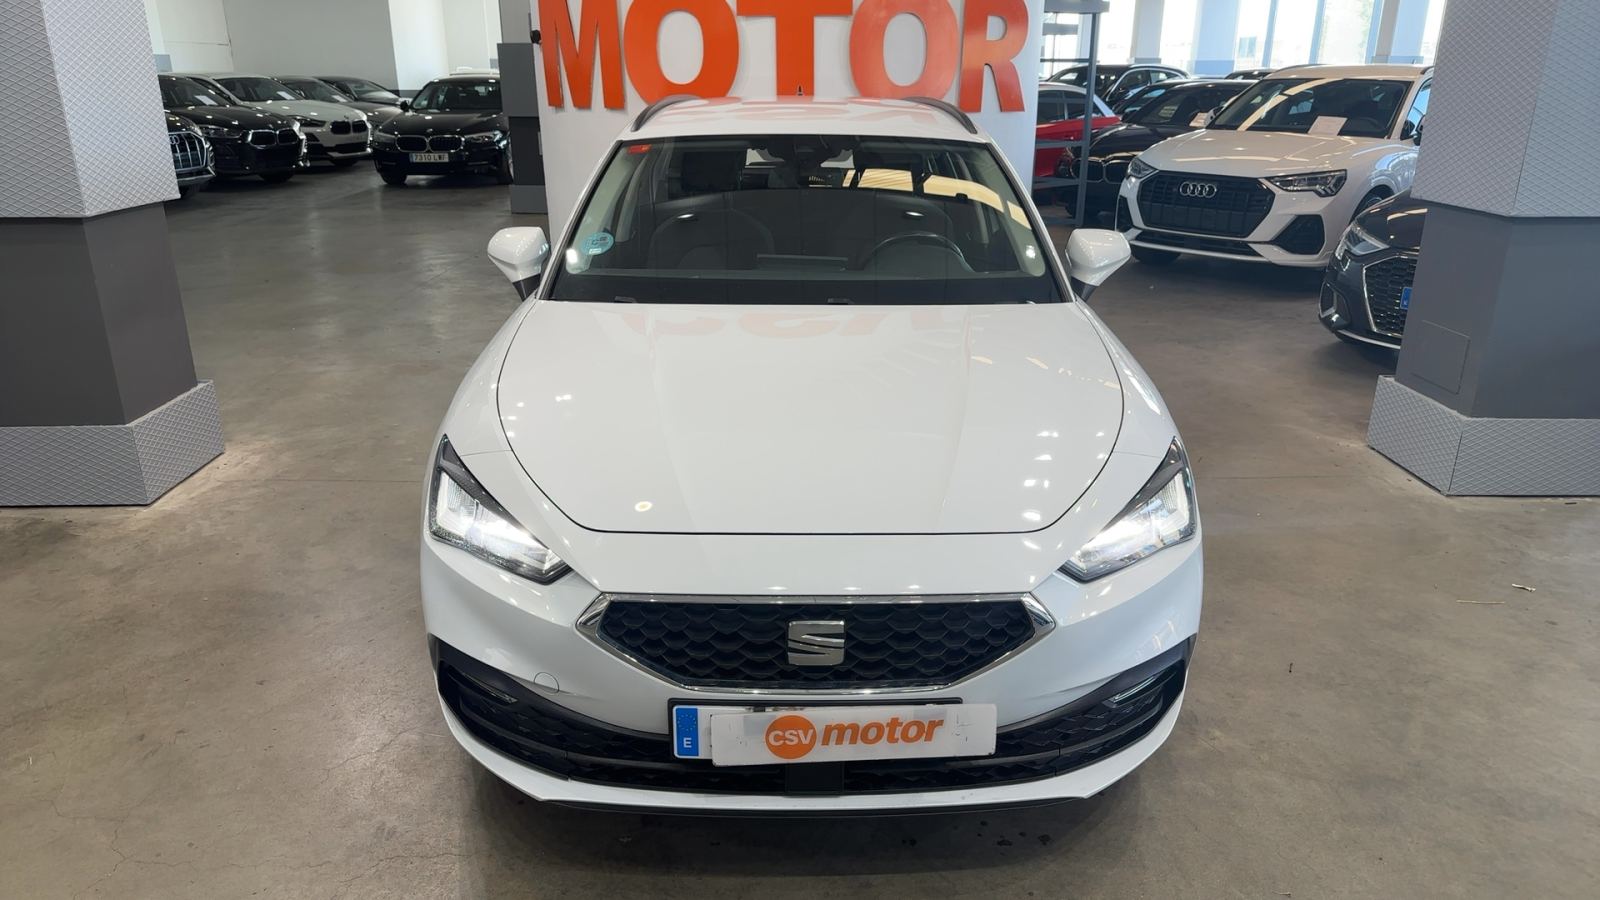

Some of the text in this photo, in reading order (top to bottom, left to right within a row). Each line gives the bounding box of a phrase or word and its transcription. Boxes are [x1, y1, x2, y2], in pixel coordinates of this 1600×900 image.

[537, 0, 1029, 113] MOTOR
[683, 737, 692, 749] E
[820, 717, 945, 747] motor
